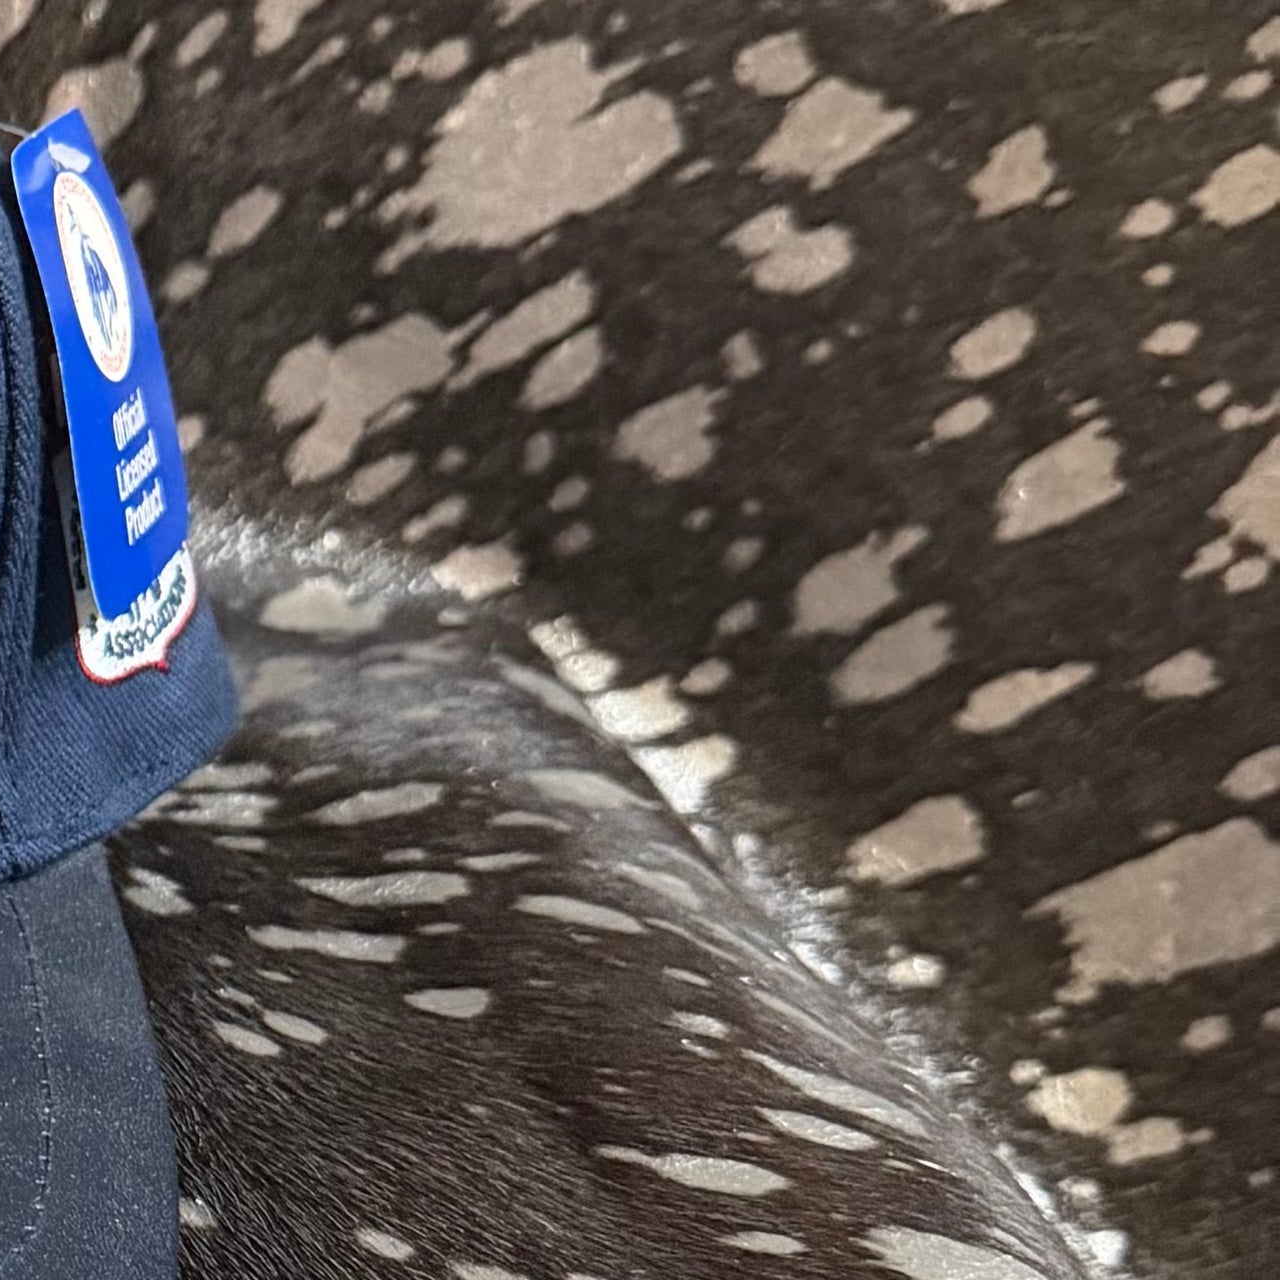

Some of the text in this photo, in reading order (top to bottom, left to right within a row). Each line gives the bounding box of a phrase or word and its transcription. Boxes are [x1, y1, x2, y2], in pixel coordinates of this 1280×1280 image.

[112, 387, 146, 451] Official
[116, 429, 159, 502] Licensed
[125, 477, 164, 546] Product
